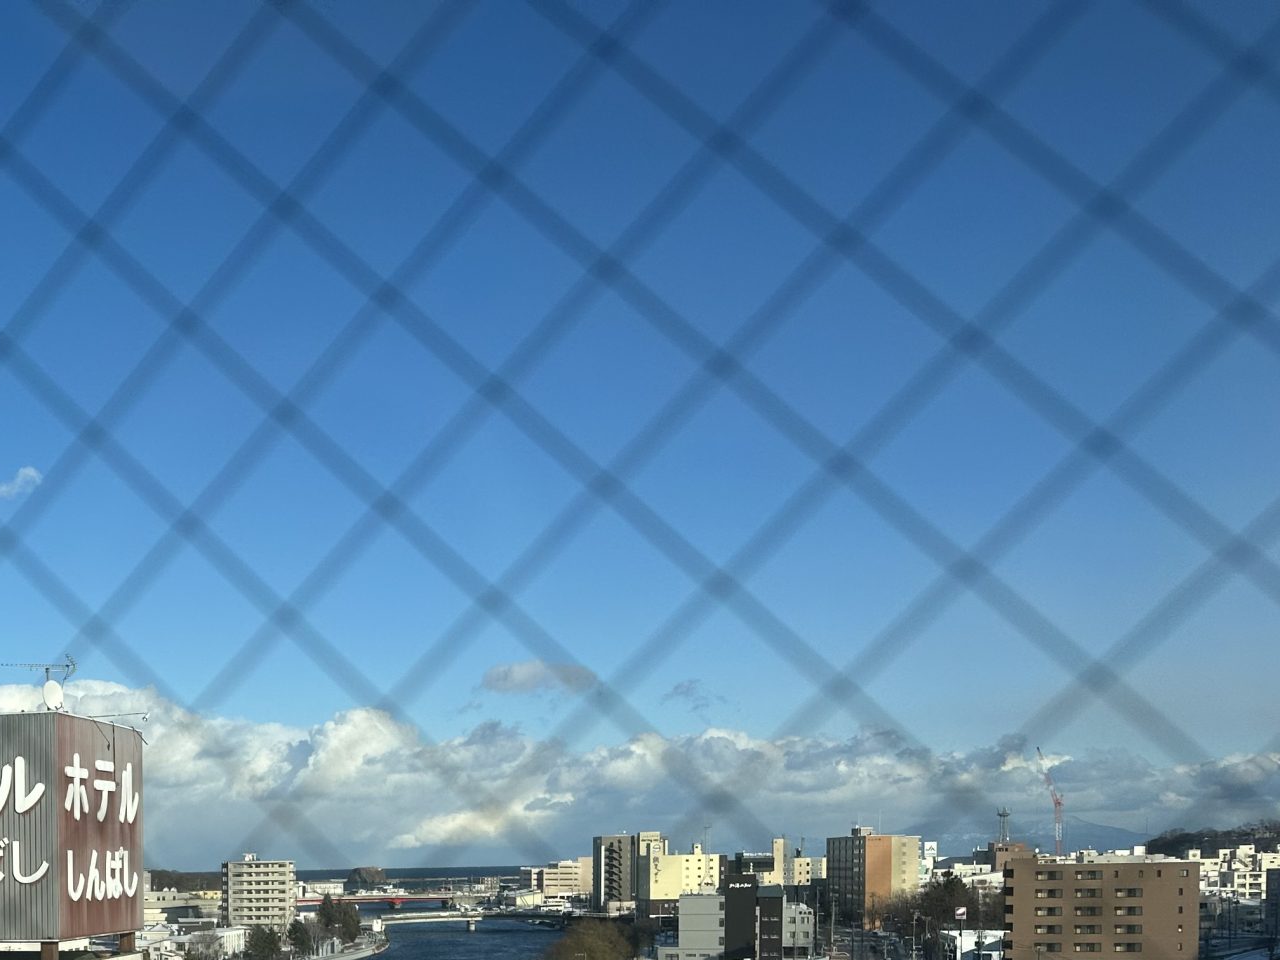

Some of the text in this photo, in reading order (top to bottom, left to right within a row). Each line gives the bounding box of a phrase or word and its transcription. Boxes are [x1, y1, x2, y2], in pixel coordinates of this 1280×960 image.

[64, 752, 140, 824] ホテル
[66, 846, 139, 902] しんばし
